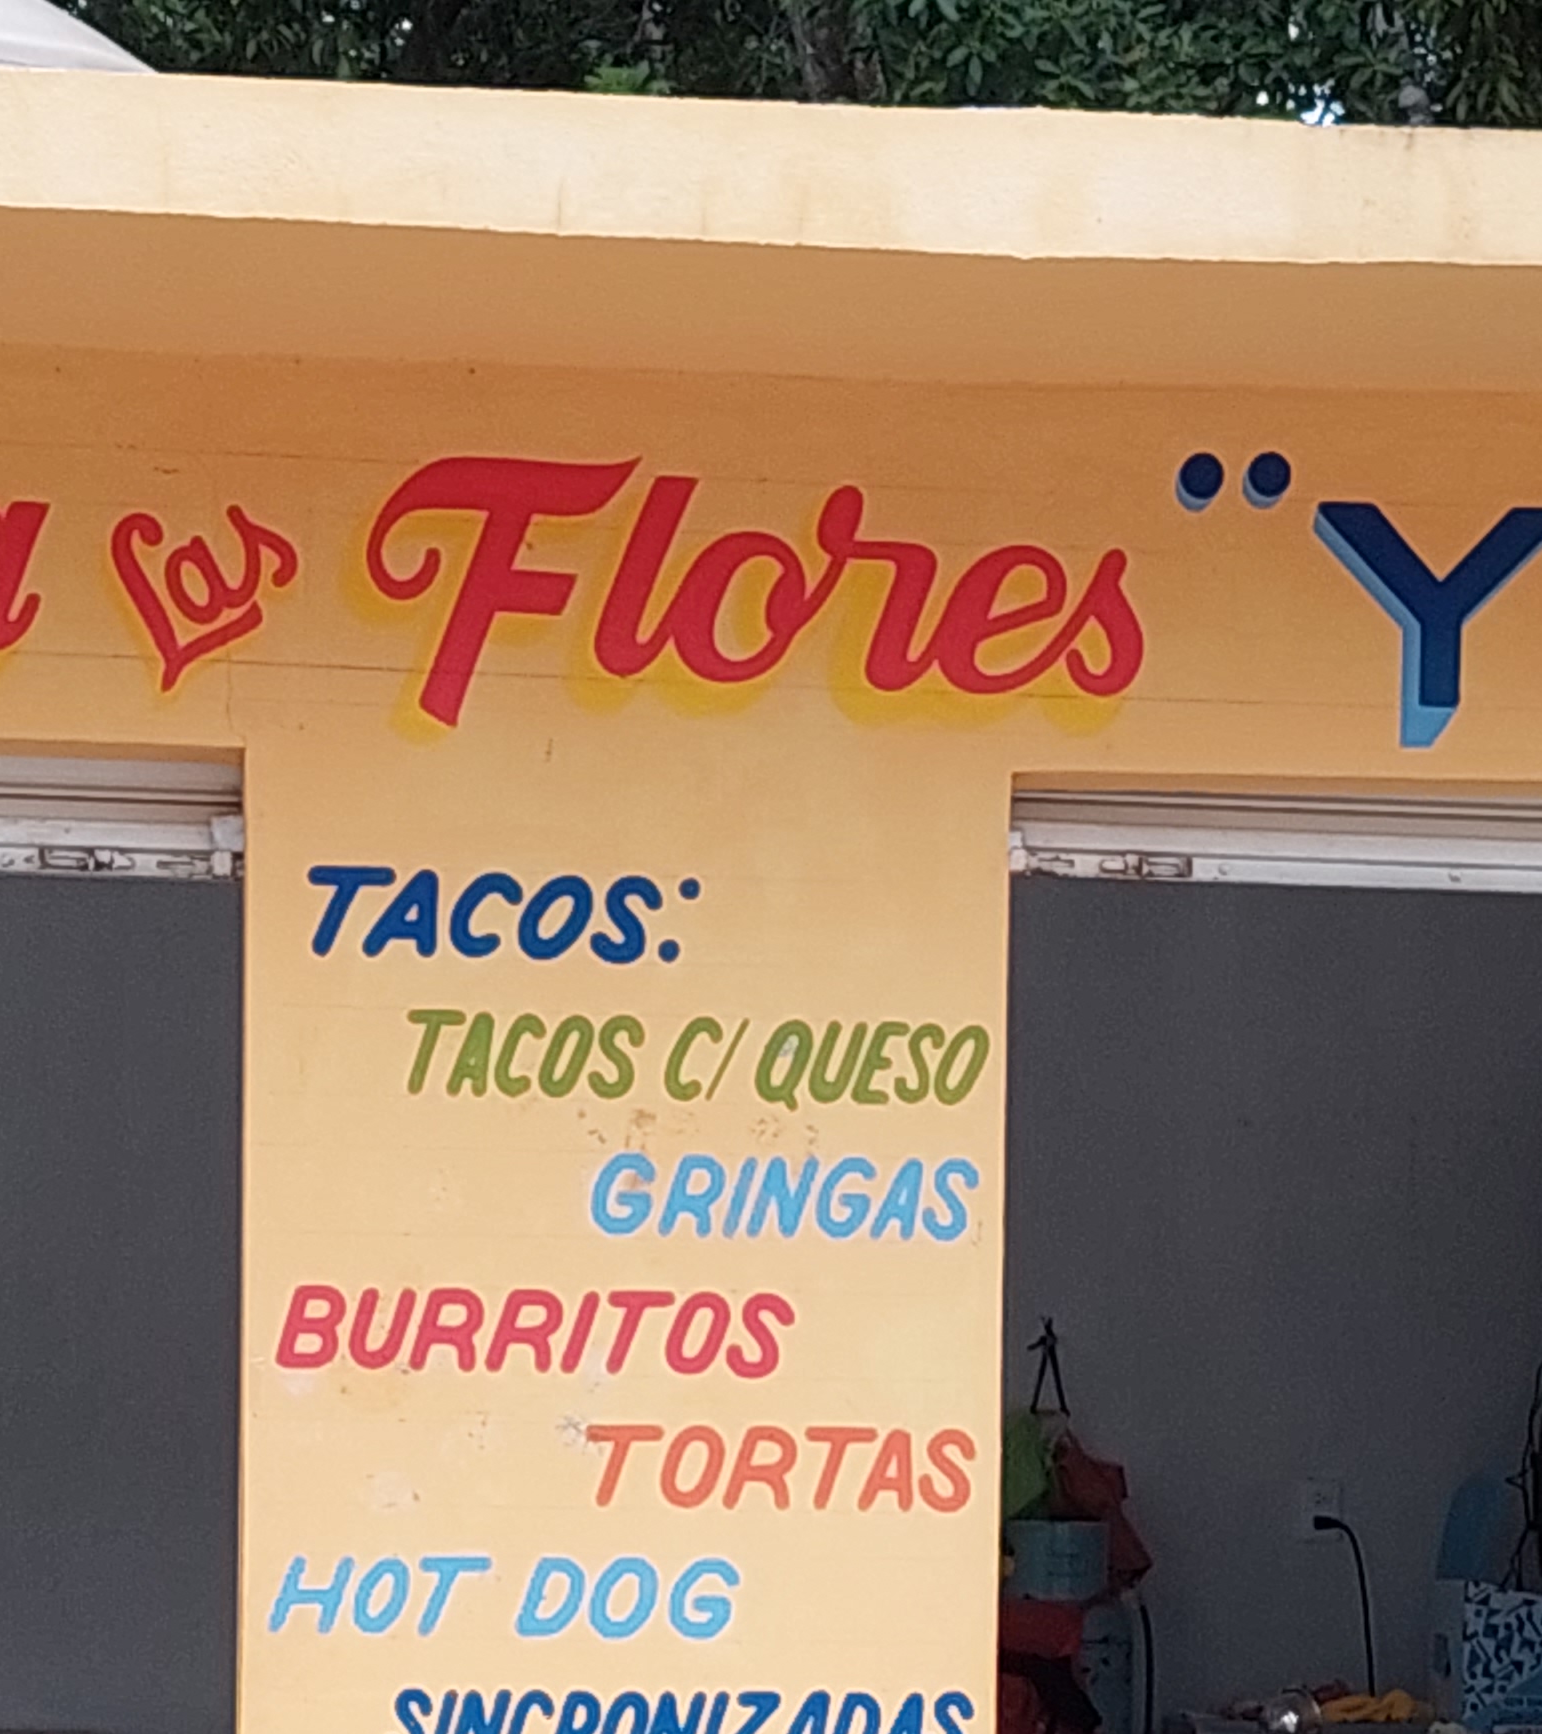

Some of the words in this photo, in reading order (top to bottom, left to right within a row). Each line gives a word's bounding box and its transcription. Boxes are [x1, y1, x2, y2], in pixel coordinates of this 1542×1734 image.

[110, 504, 299, 692] Las
[365, 455, 1145, 728] Flores
[307, 865, 701, 965] TACOS:
[407, 1008, 646, 1100] TACOS
[663, 1015, 750, 1102] C/
[754, 1018, 990, 1111] QUESO
[589, 1152, 980, 1242] GRINGAS
[274, 1283, 797, 1380] BURRITOS
[585, 1424, 977, 1513] TORTAS
[267, 1555, 493, 1637] HOT
[514, 1555, 742, 1640] DOG
